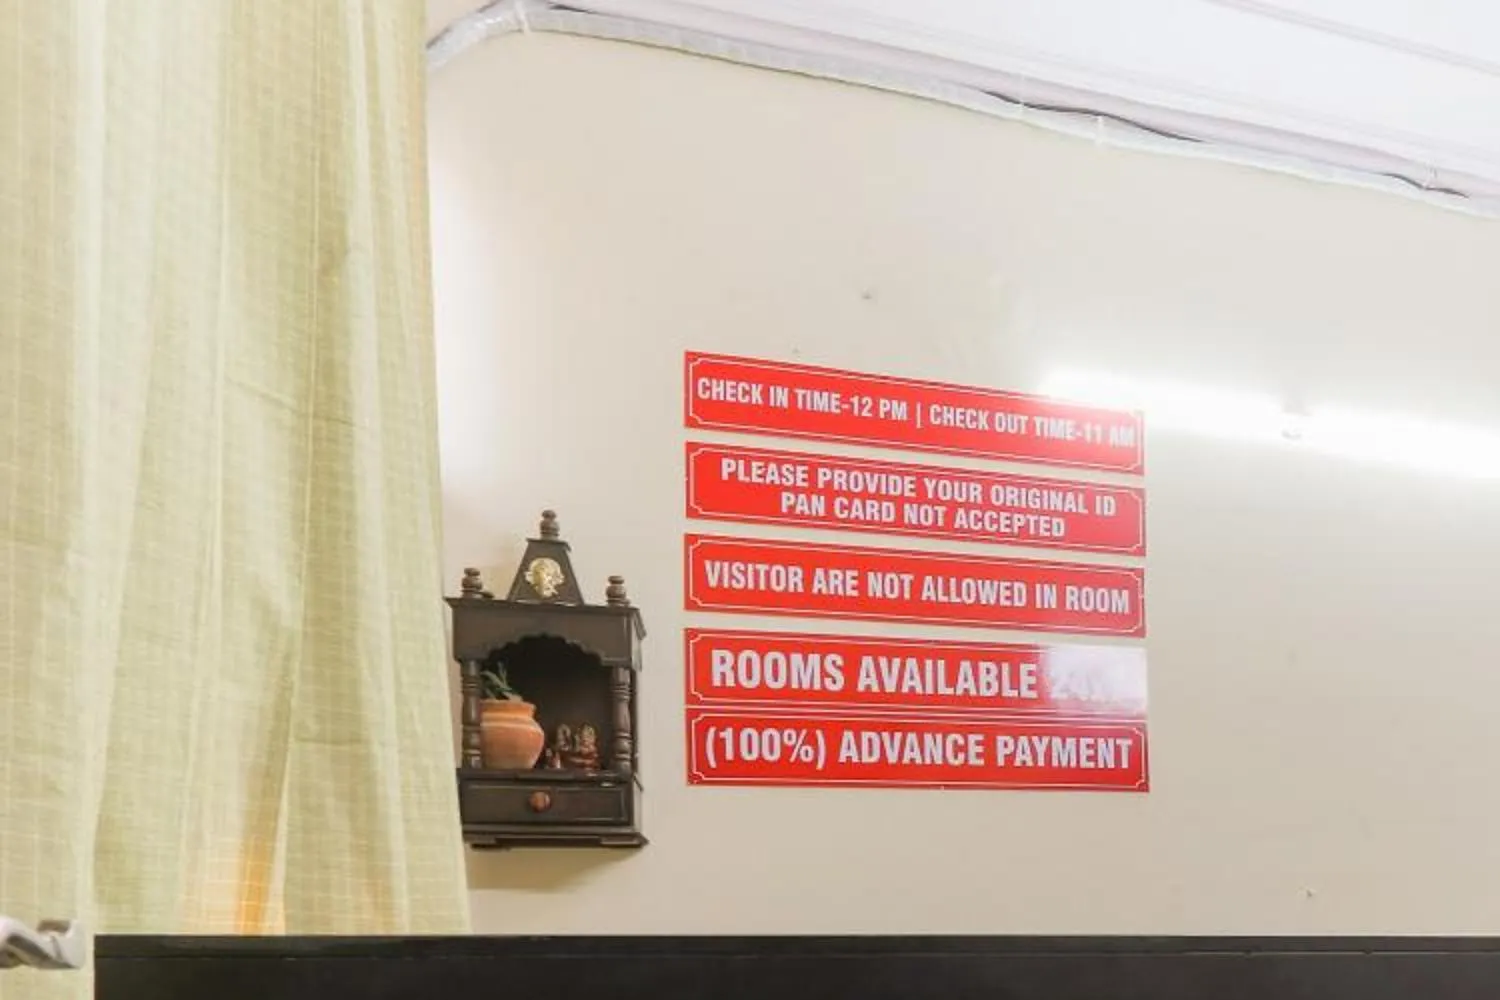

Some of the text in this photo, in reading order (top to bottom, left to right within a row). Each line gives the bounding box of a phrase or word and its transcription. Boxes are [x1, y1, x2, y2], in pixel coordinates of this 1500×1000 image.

[697, 377, 764, 405] CHECK
[769, 385, 789, 408] IN
[794, 389, 873, 417] TIME-12
[879, 398, 908, 421] PM
[929, 404, 989, 431] CHECK
[995, 411, 1029, 434] OUT
[1033, 416, 1102, 444] TIME-11
[1108, 424, 1136, 448] AM
[721, 457, 1116, 516] PLEASE PROVIDE YOUR ORIGINAL ID
[781, 491, 1065, 537] PAN CARD NOT ACCEPTED
[704, 559, 1130, 615] VISITOR ARE NOT ALLOWED IN ROOM
[711, 648, 845, 692] ROOMS
[856, 655, 1038, 698] AVAILABLE
[705, 726, 1133, 770] (100%) ADVANCE PAYMENT
